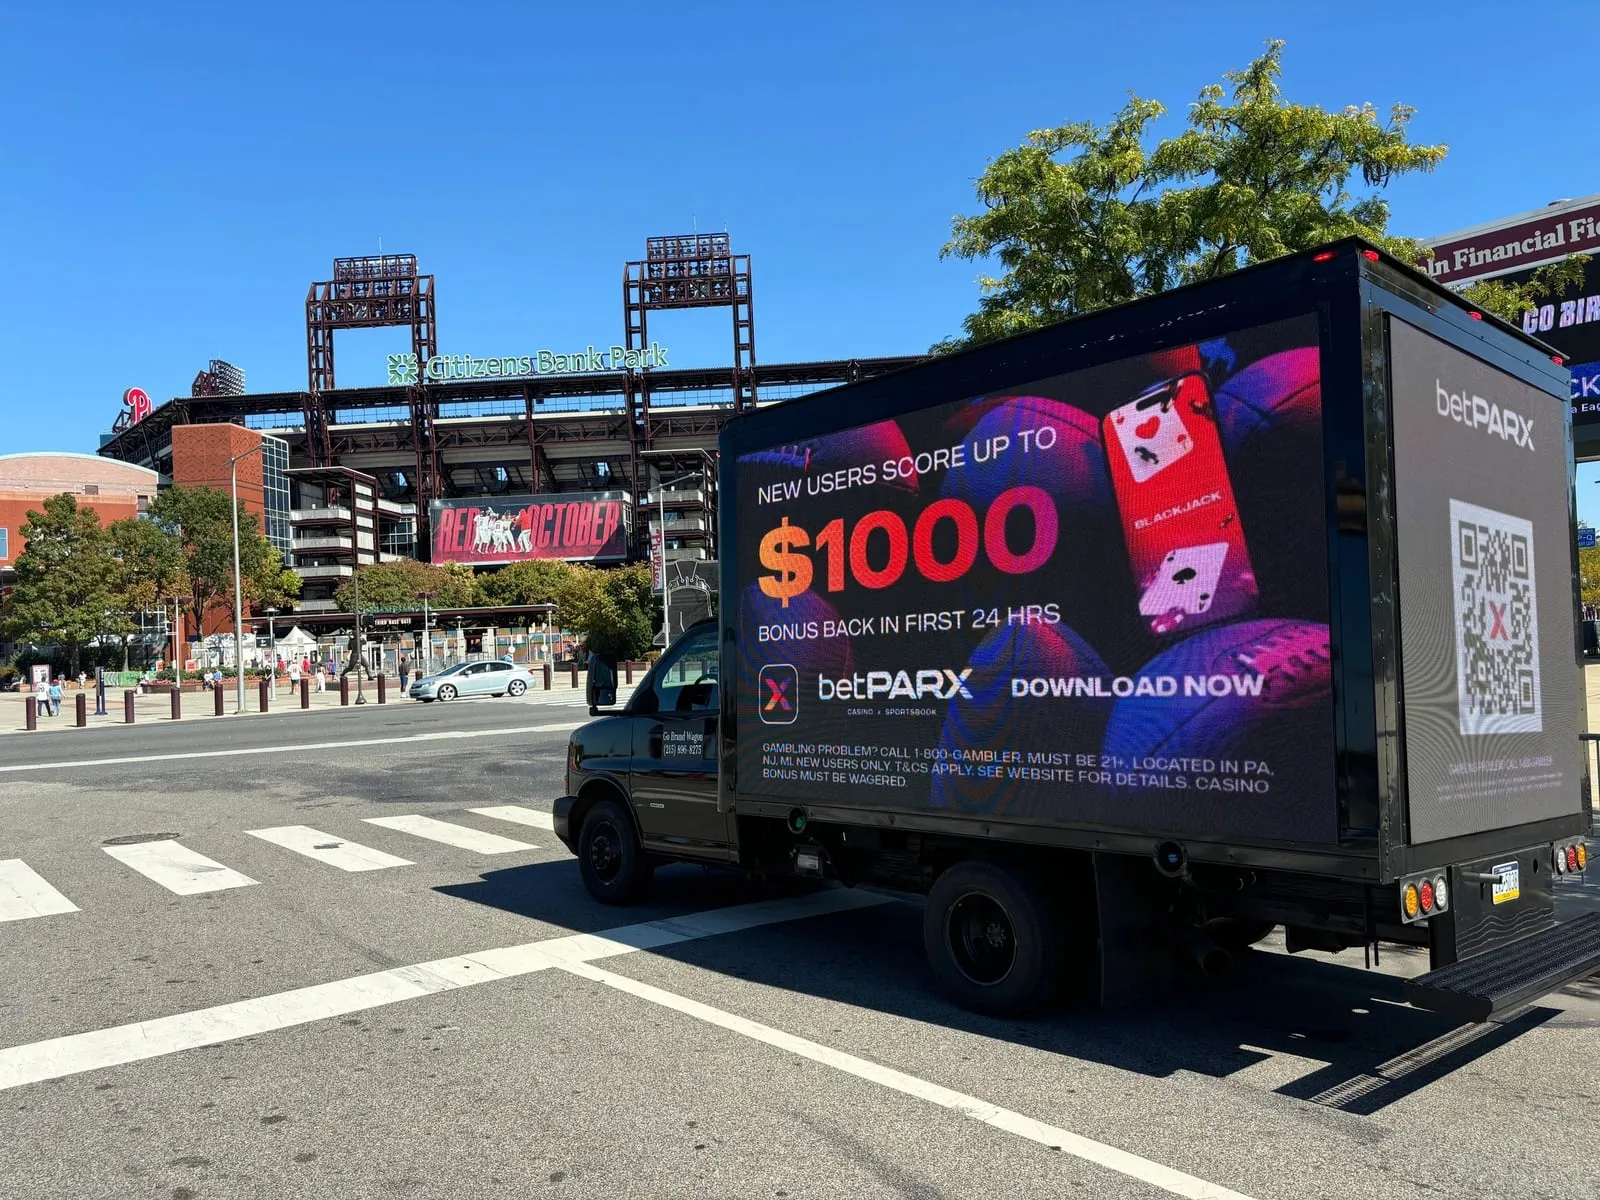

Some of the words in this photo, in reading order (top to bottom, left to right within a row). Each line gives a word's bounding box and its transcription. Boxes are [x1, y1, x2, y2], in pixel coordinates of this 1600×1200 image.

[1452, 223, 1566, 271] Financial
[1522, 304, 1555, 335] GO
[1559, 294, 1600, 328] BIR
[427, 355, 534, 380] Citizens
[536, 346, 602, 374] Bank
[608, 342, 668, 369] Park
[1436, 377, 1535, 453] betPARX
[758, 479, 802, 505] NEW
[807, 464, 877, 496] USERS
[882, 445, 966, 481] SCORE
[973, 435, 1010, 463] UP
[1017, 426, 1057, 453] TO
[438, 507, 482, 552] RED
[525, 501, 621, 548] OCTOBER
[1134, 491, 1222, 530] BLACKJACK
[757, 485, 1059, 609] $1000
[758, 622, 819, 642] BONUS
[823, 618, 875, 637] BACK
[880, 616, 899, 634] IN
[905, 611, 966, 632] FIRST
[972, 609, 1000, 629] 24
[1007, 603, 1062, 626] HRS
[818, 668, 973, 700] betPARX
[1011, 677, 1177, 697] DOWNLOAD
[1184, 674, 1265, 697] NOW
[847, 708, 874, 716] CASINO
[885, 708, 937, 716] SPORTSBOOK
[663, 731, 670, 741] Go
[671, 730, 686, 741] Brand
[686, 731, 704, 744] Wagon
[663, 744, 676, 757] (215)
[763, 743, 815, 753] GAMBLING
[818, 745, 878, 756] PROBLEM?
[880, 747, 911, 758] CALL
[1028, 752, 1071, 765] MUST
[1076, 754, 1096, 766] BE
[1133, 757, 1216, 772] LOCATED
[1220, 760, 1239, 773] IN
[796, 757, 820, 768] NEW
[822, 759, 859, 769] USERS
[895, 761, 928, 773] T&CS
[931, 763, 975, 776] APPLY.
[977, 765, 1003, 778] SEE
[1007, 767, 1074, 782] WEBSITE
[1078, 770, 1111, 785] FOR
[1116, 772, 1191, 789] DETAILS.
[1195, 776, 1270, 794] CASINO
[763, 769, 798, 779] BONUS
[800, 771, 829, 781] MUST
[832, 773, 847, 783] BE
[849, 774, 908, 787] WAGERED.
